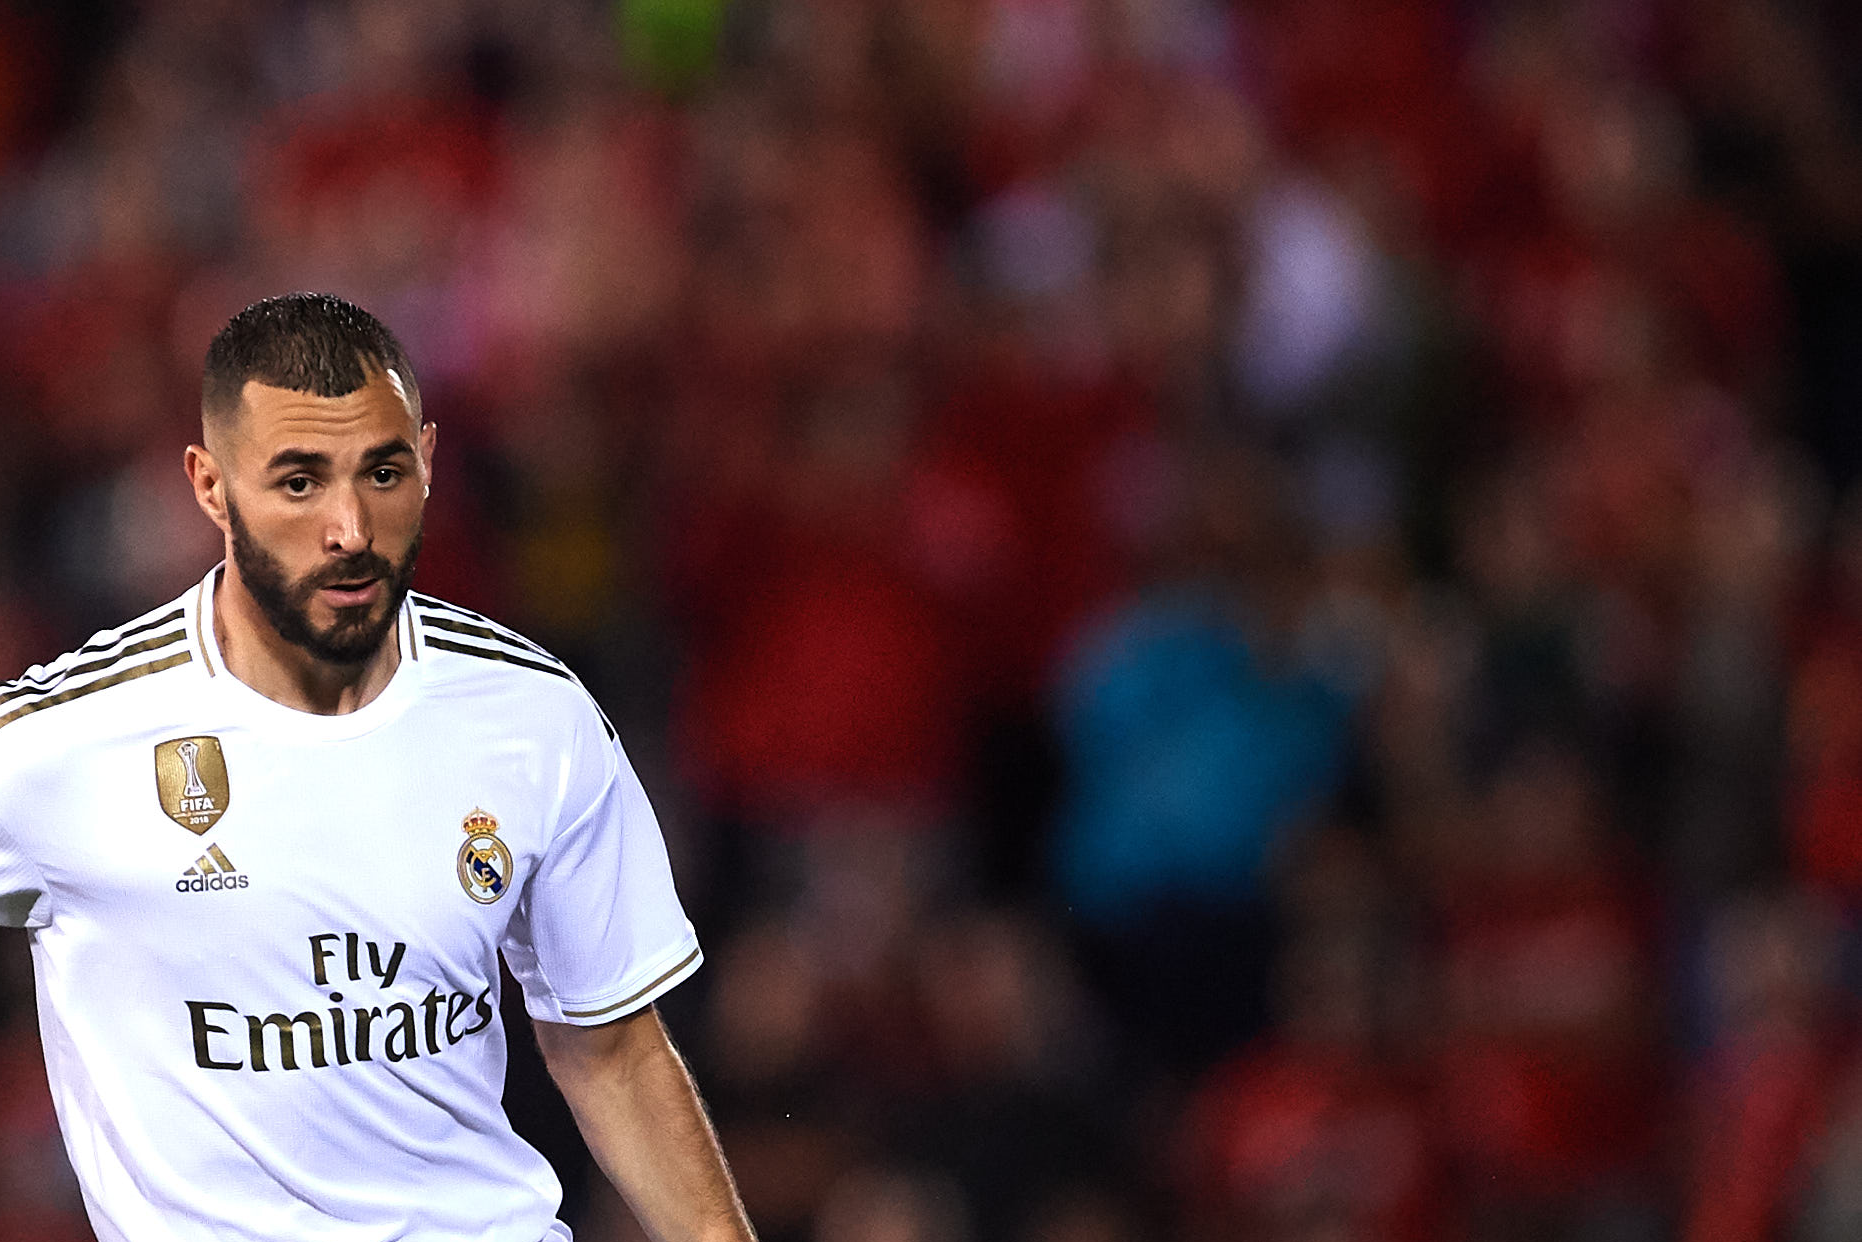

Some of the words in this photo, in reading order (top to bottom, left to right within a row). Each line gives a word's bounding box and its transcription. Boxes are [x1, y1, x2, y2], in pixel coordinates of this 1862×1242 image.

[179, 797, 215, 812] FIFA
[175, 872, 249, 893] adidas
[308, 932, 406, 989] Fly
[184, 985, 493, 1072] Emirates
